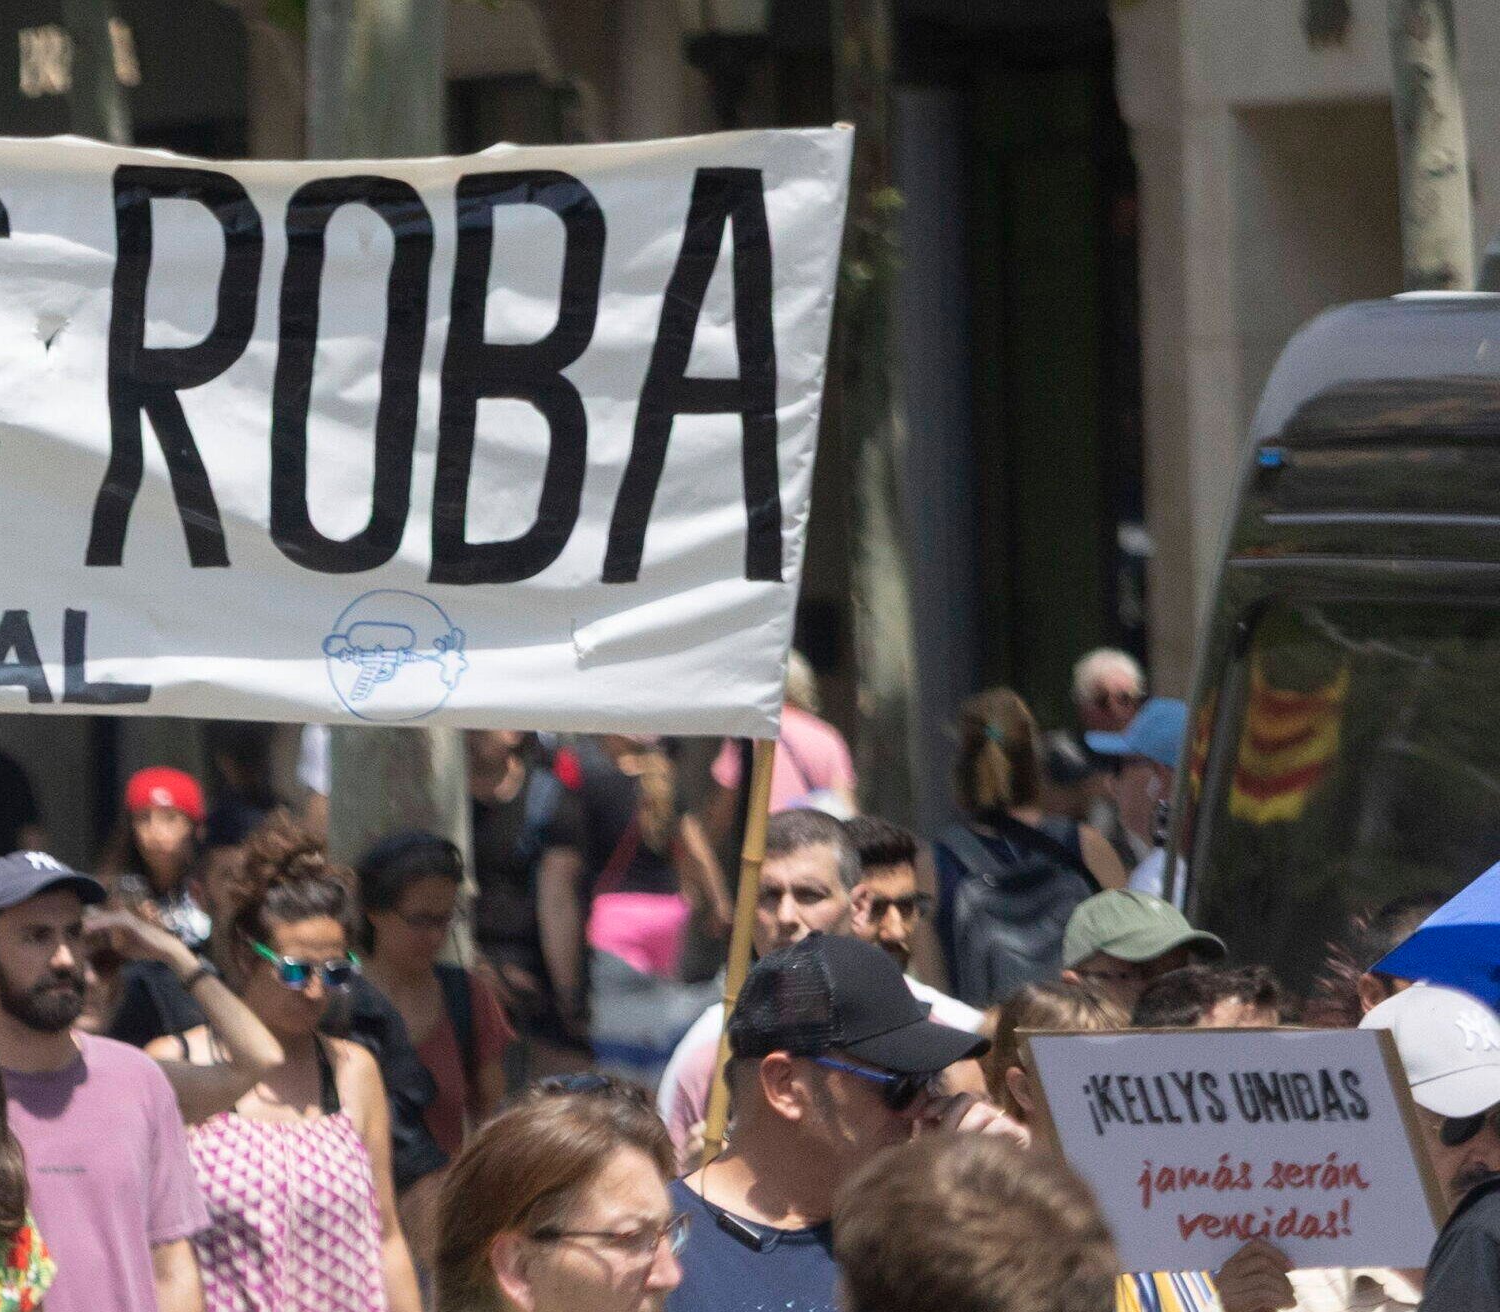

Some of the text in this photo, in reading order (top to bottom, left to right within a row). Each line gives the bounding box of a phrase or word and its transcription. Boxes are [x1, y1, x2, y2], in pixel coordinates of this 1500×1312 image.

[84, 165, 783, 585] ROBA
[1229, 1068, 1370, 1123] UNIDAS
[1137, 1151, 1370, 1209] jamás serán
[1177, 1197, 1351, 1241] vencidas!
